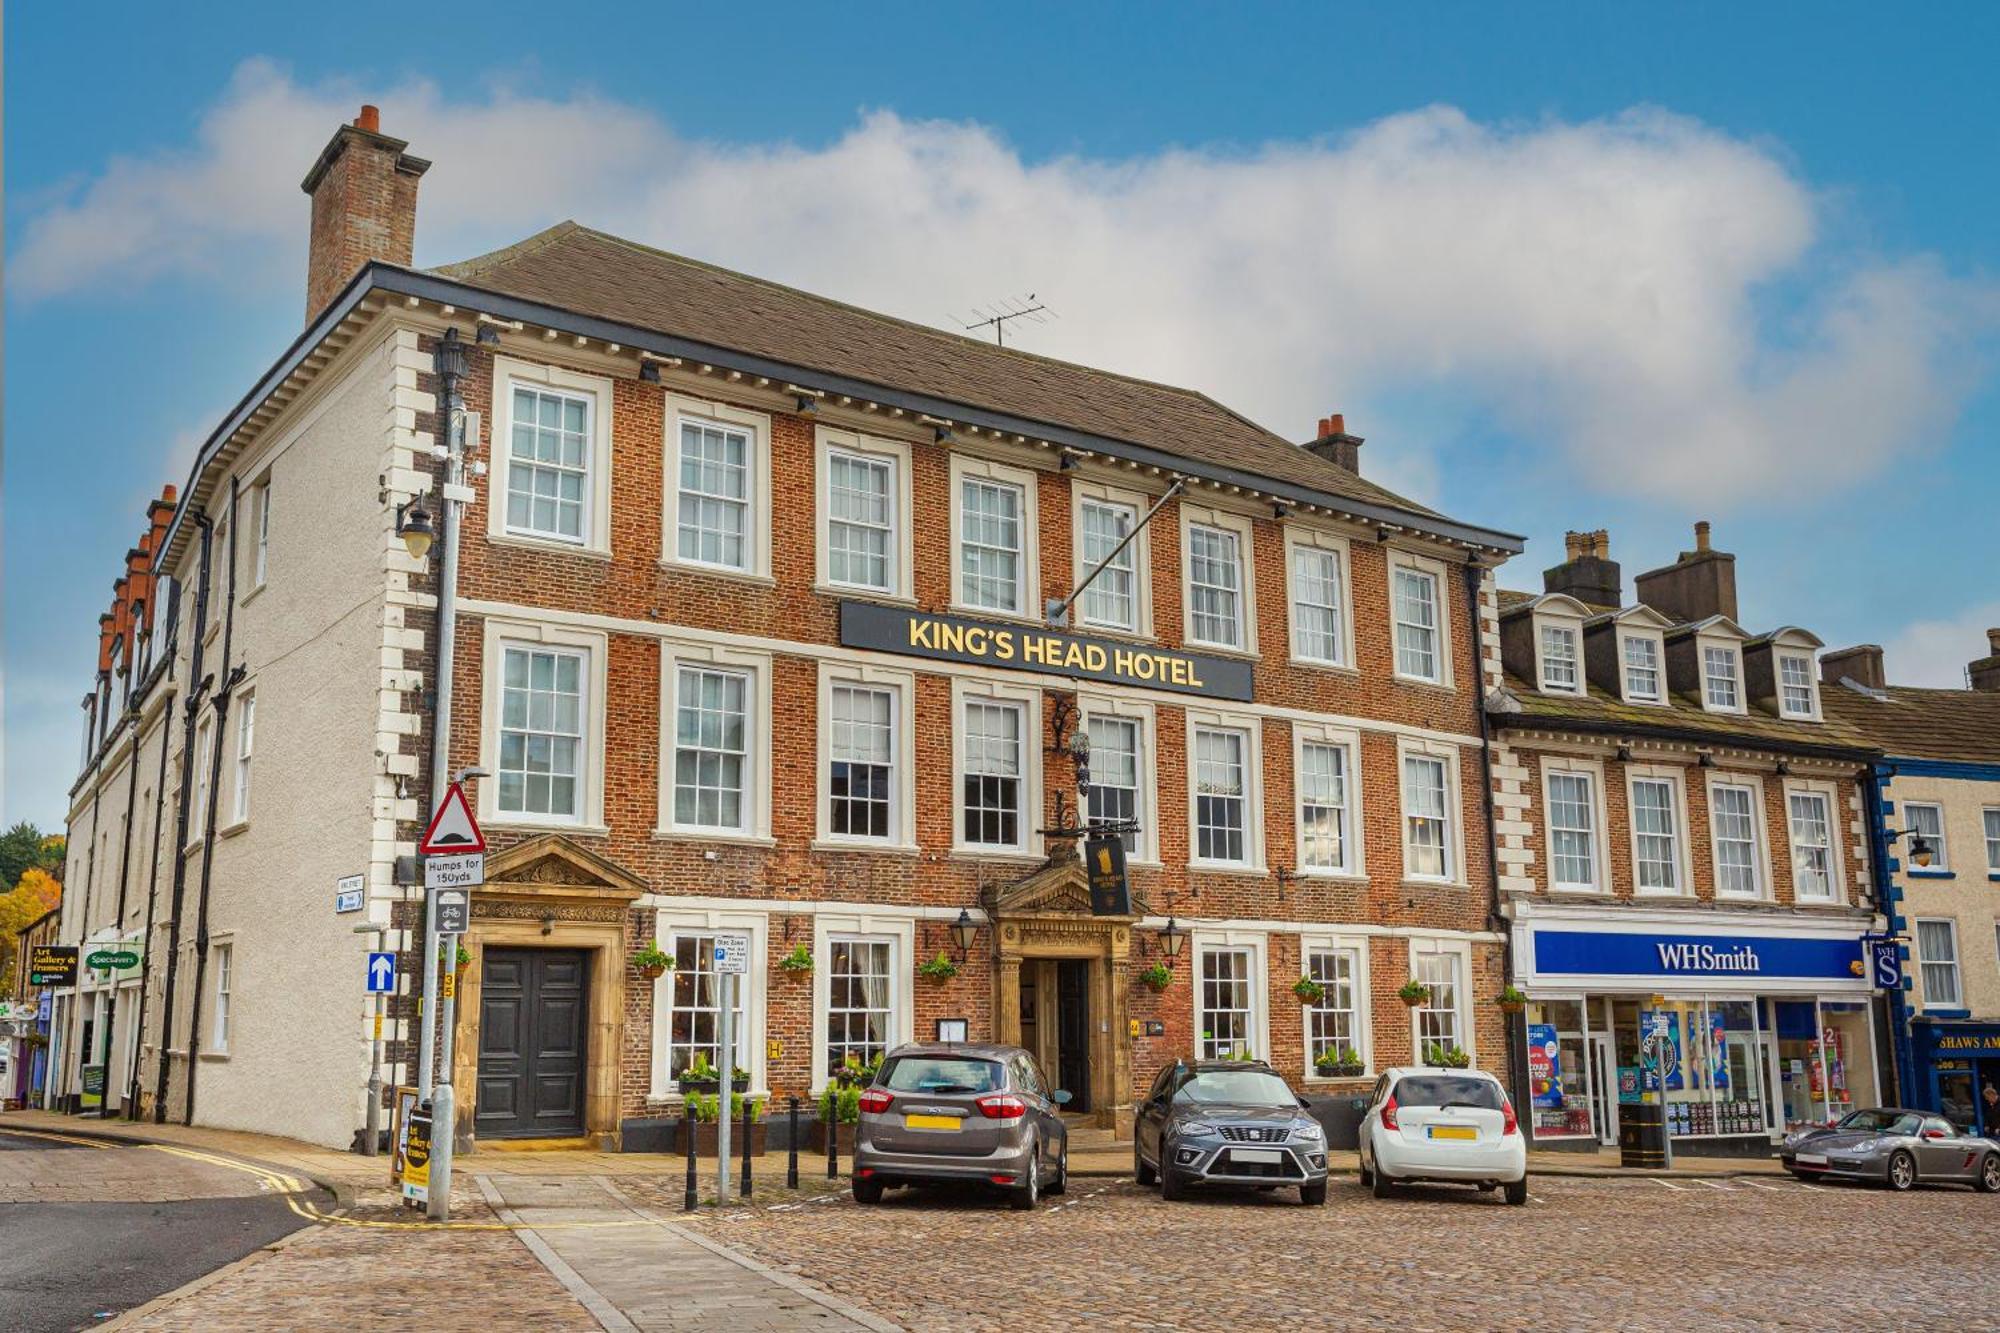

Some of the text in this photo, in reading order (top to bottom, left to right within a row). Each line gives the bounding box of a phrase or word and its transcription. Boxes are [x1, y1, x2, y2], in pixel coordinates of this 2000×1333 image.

[909, 618, 1203, 688] KING'S HEAD HOTEL
[429, 859, 479, 871] Humps for
[1656, 942, 1760, 972] WHSmith
[1877, 947, 1895, 956] WH
[33, 956, 65, 964] Gallery
[91, 955, 134, 965] Specsavers
[1879, 955, 1898, 985] S
[1939, 1036, 1980, 1048] SHAWS
[770, 1043, 779, 1056] H
